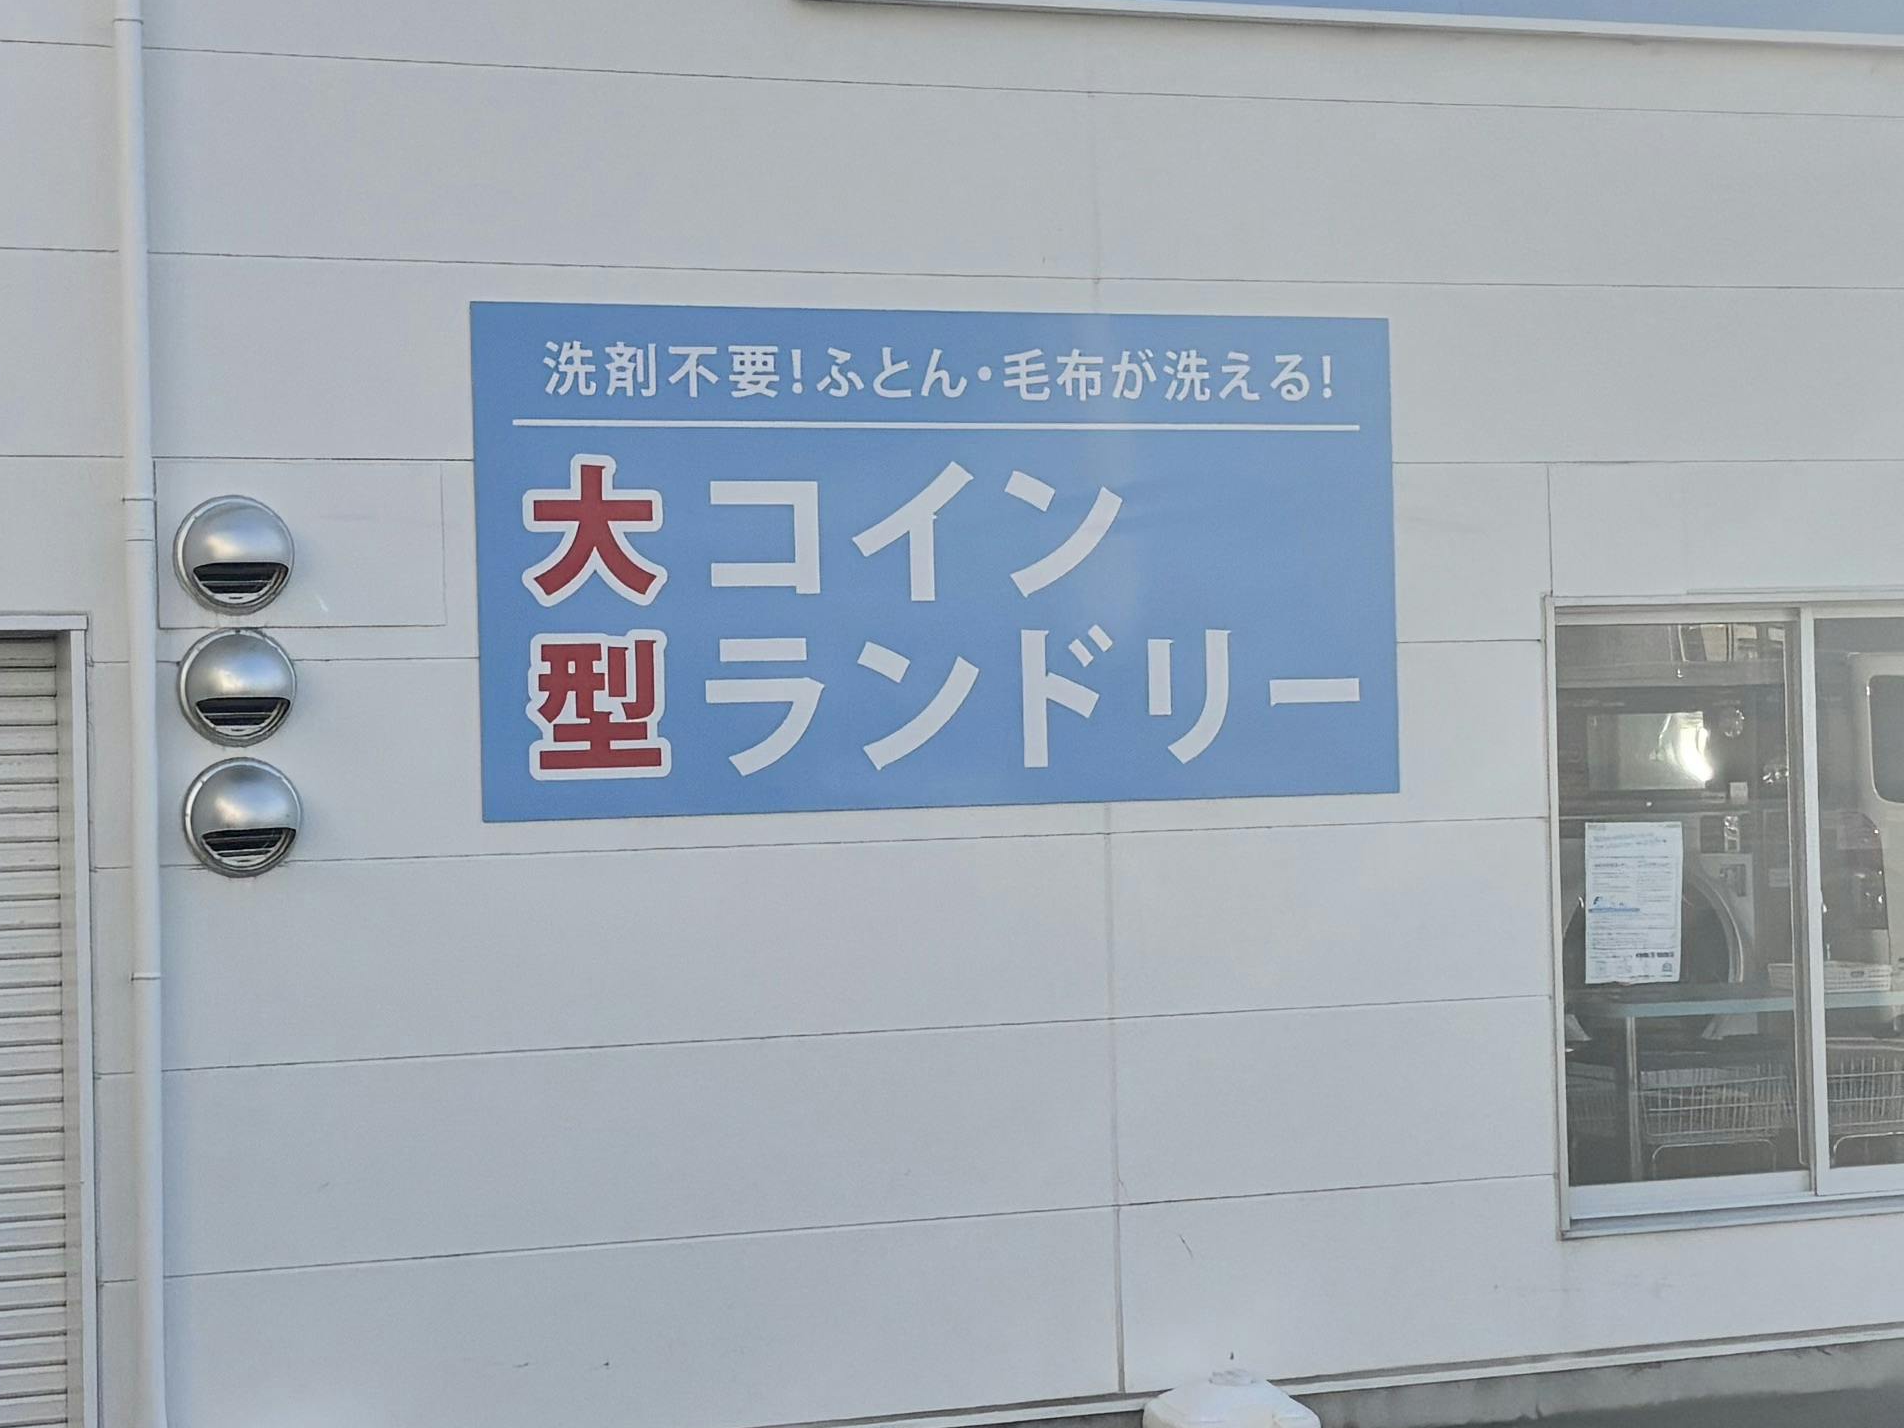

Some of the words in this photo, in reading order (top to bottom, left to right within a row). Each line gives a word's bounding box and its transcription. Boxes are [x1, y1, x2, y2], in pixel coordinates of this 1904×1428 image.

[709, 461, 1123, 601] コイン
[705, 625, 1360, 776] ランドリー
